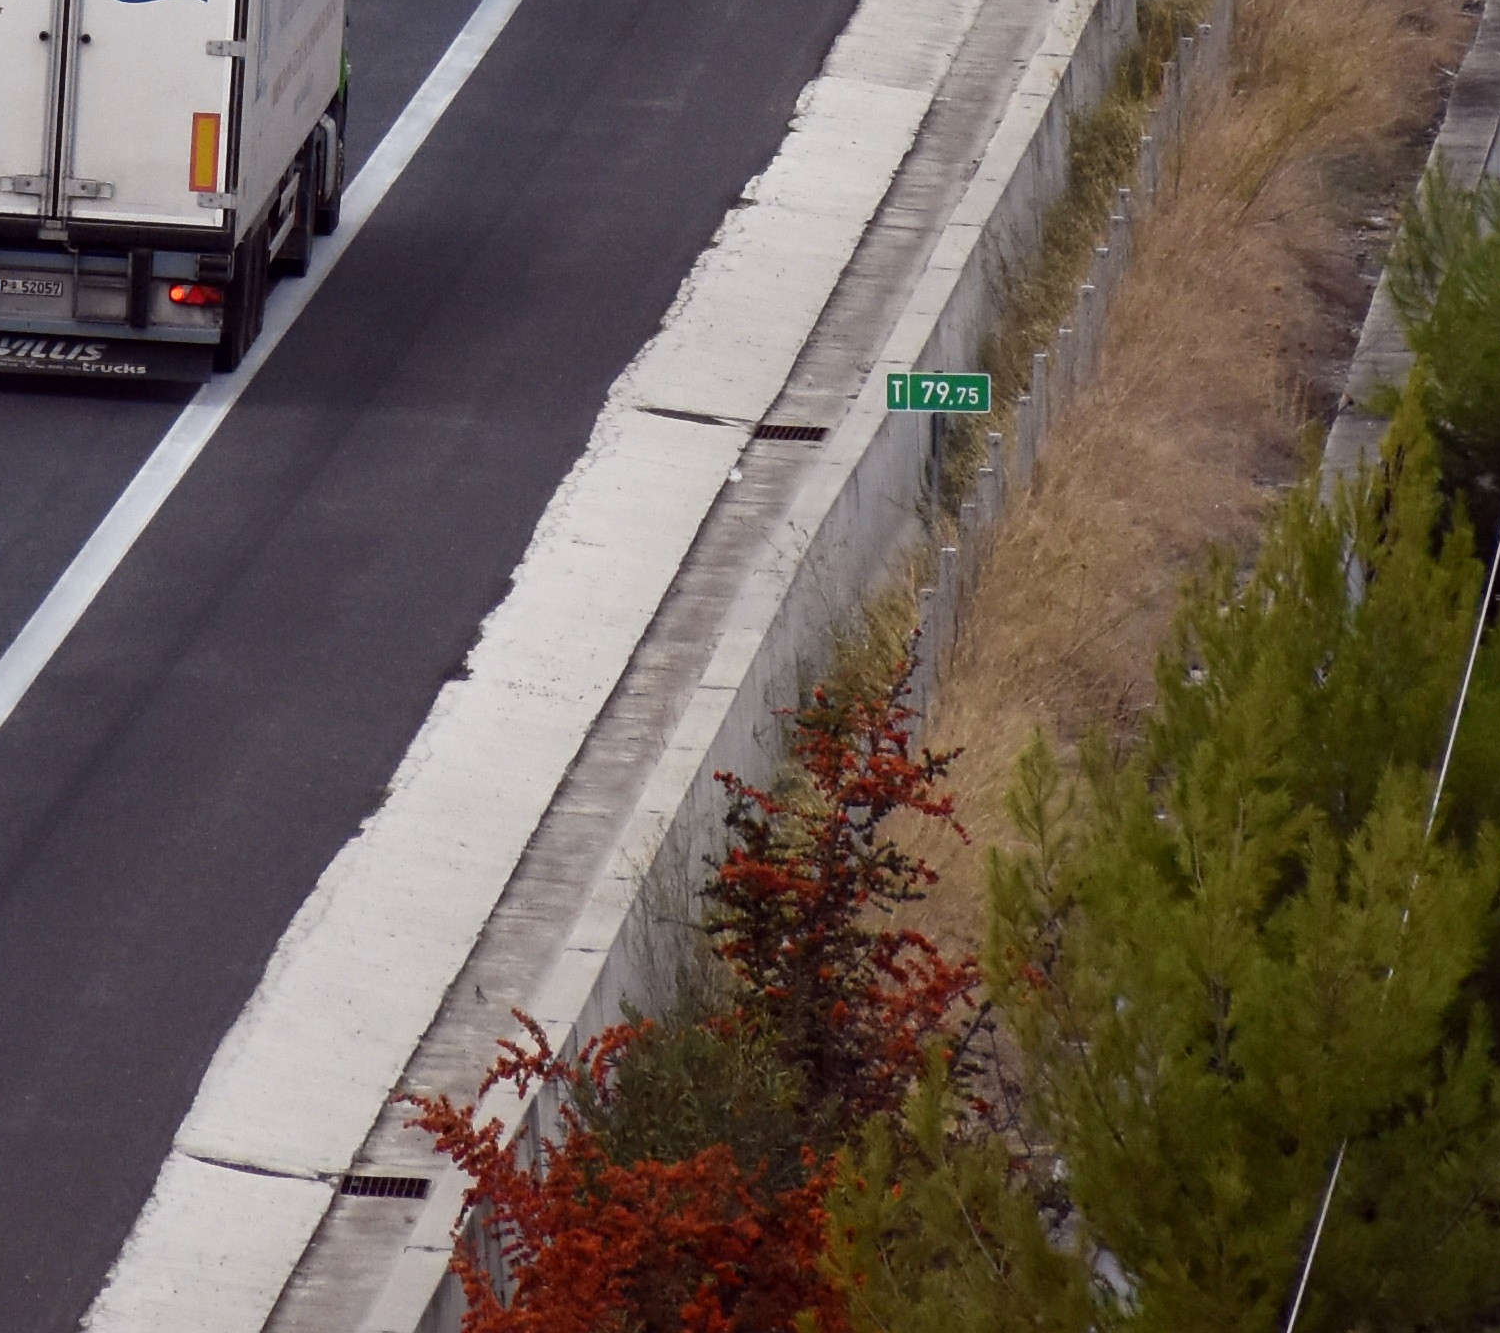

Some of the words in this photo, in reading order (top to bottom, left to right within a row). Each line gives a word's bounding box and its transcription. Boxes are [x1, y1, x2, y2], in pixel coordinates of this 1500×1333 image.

[21, 282, 61, 295] 52057
[82, 361, 147, 375] trucks
[891, 380, 904, 403] T
[920, 380, 979, 406] 79,75
